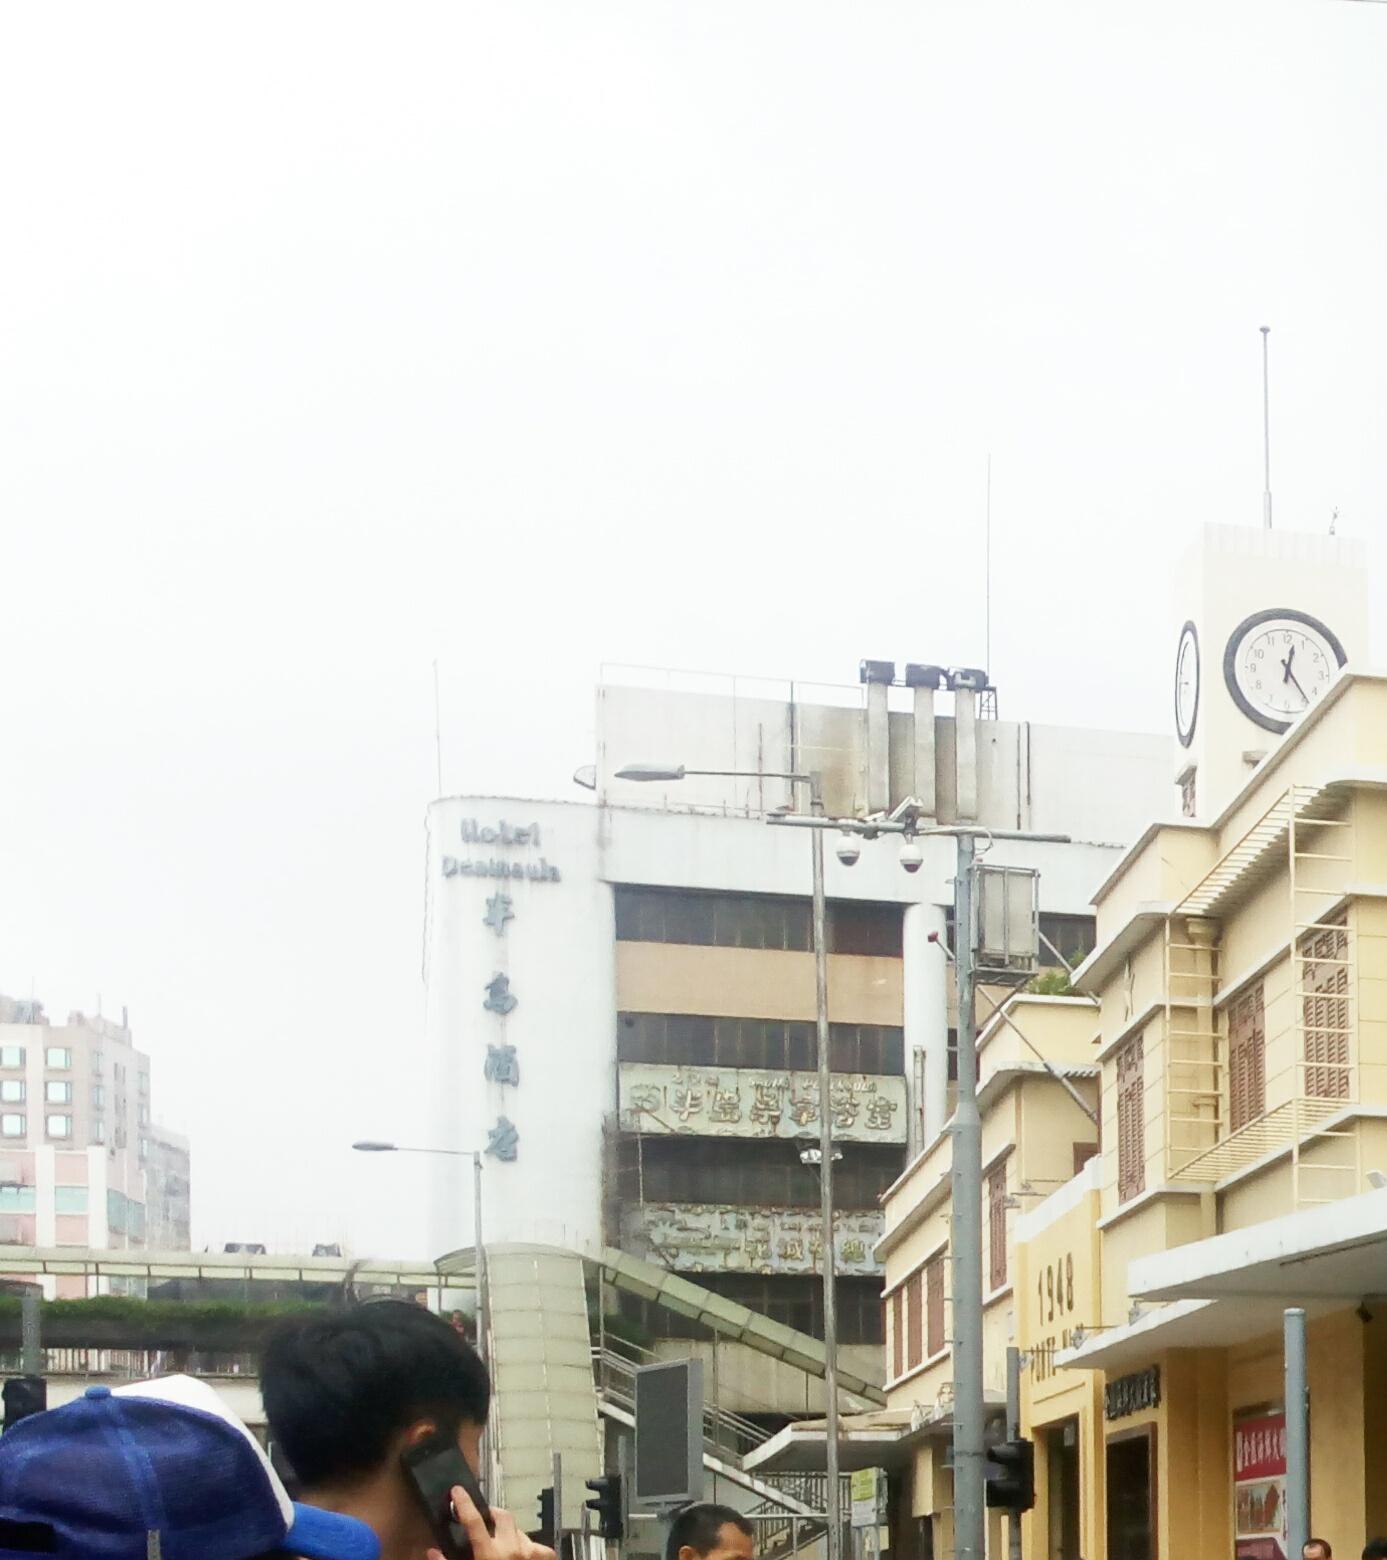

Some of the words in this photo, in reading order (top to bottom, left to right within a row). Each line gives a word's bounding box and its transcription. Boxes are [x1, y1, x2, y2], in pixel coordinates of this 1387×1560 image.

[1266, 636, 1275, 648] 11
[1283, 633, 1293, 645] 12
[1300, 640, 1305, 650] 1
[1254, 648, 1264, 660] 10
[1312, 652, 1319, 664] 2
[1249, 663, 1257, 673] 9
[1318, 671, 1325, 681] 3
[1255, 680, 1262, 690] 8
[460, 817, 541, 848] Hotel
[1038, 1252, 1074, 1327] 1948
